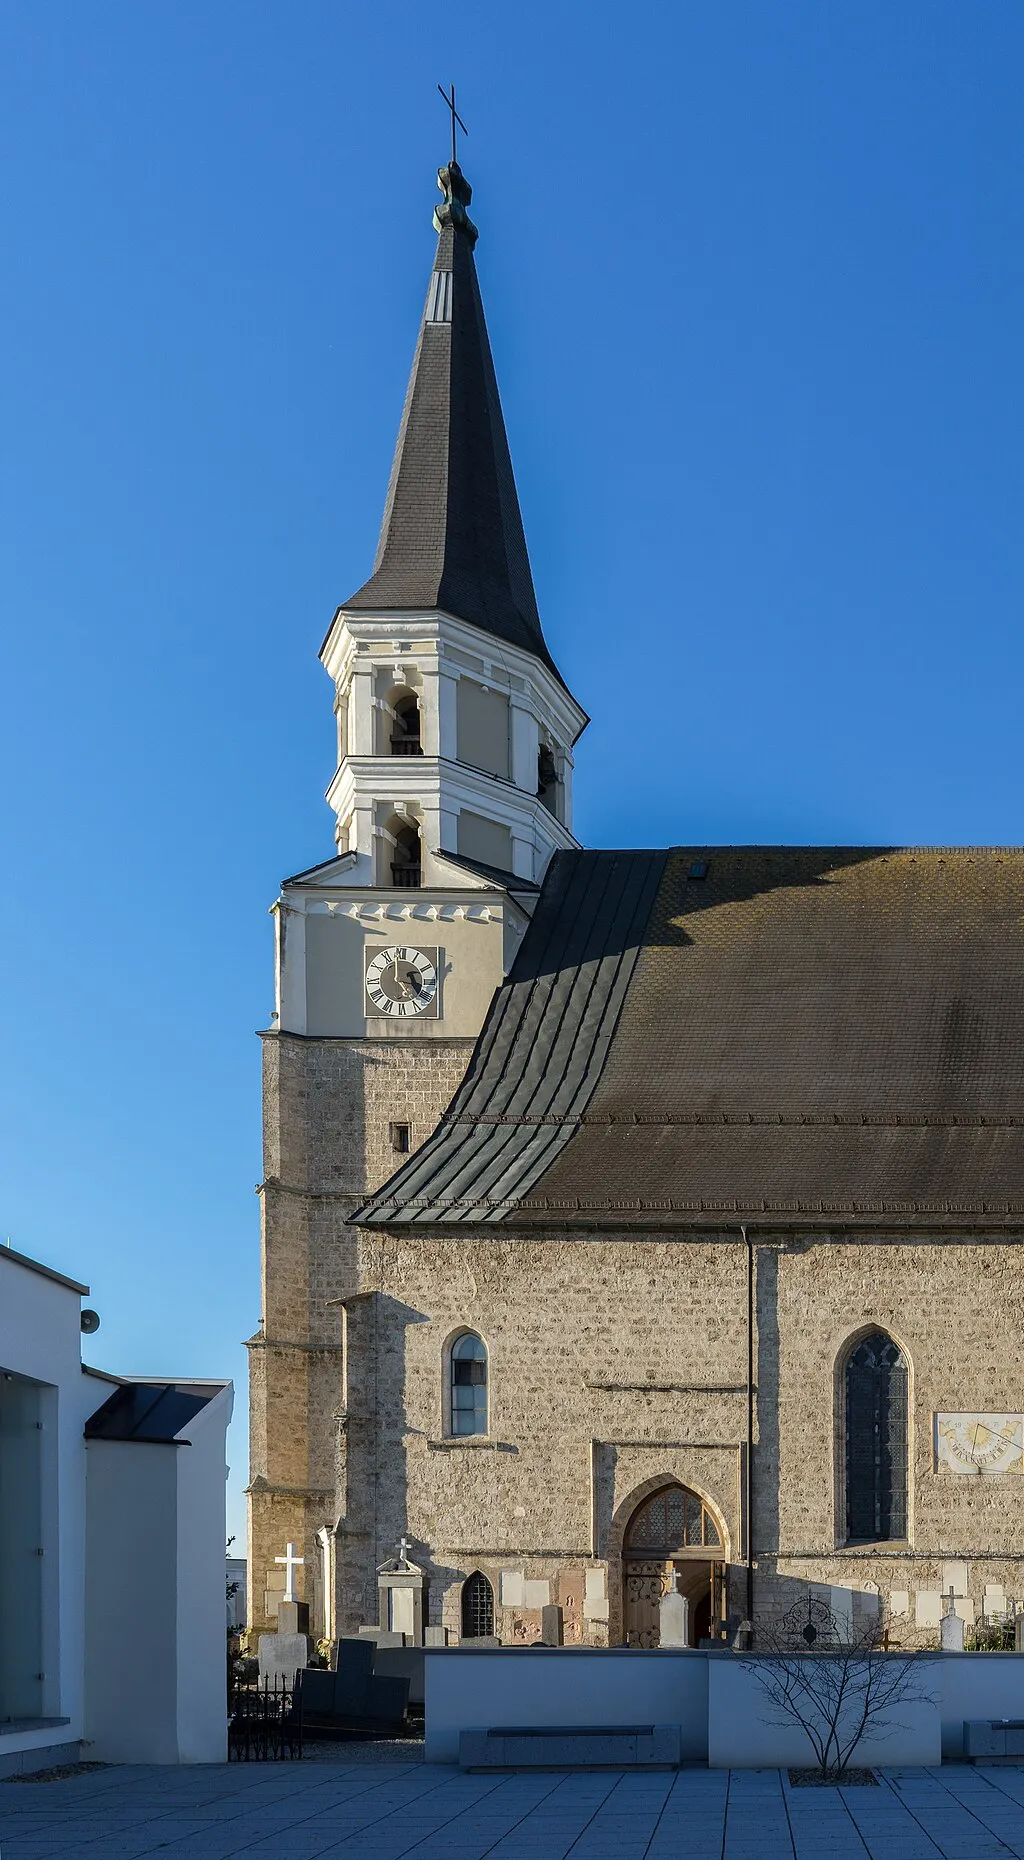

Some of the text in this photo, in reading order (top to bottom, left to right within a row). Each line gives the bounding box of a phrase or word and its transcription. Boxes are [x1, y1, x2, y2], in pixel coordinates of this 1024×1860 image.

[381, 951, 393, 964] XI
[412, 952, 420, 963] I
[371, 962, 383, 972] X
[420, 963, 432, 973] II
[382, 999, 394, 1013] VII
[398, 1003, 406, 1015] VI
[412, 1000, 421, 1012] V
